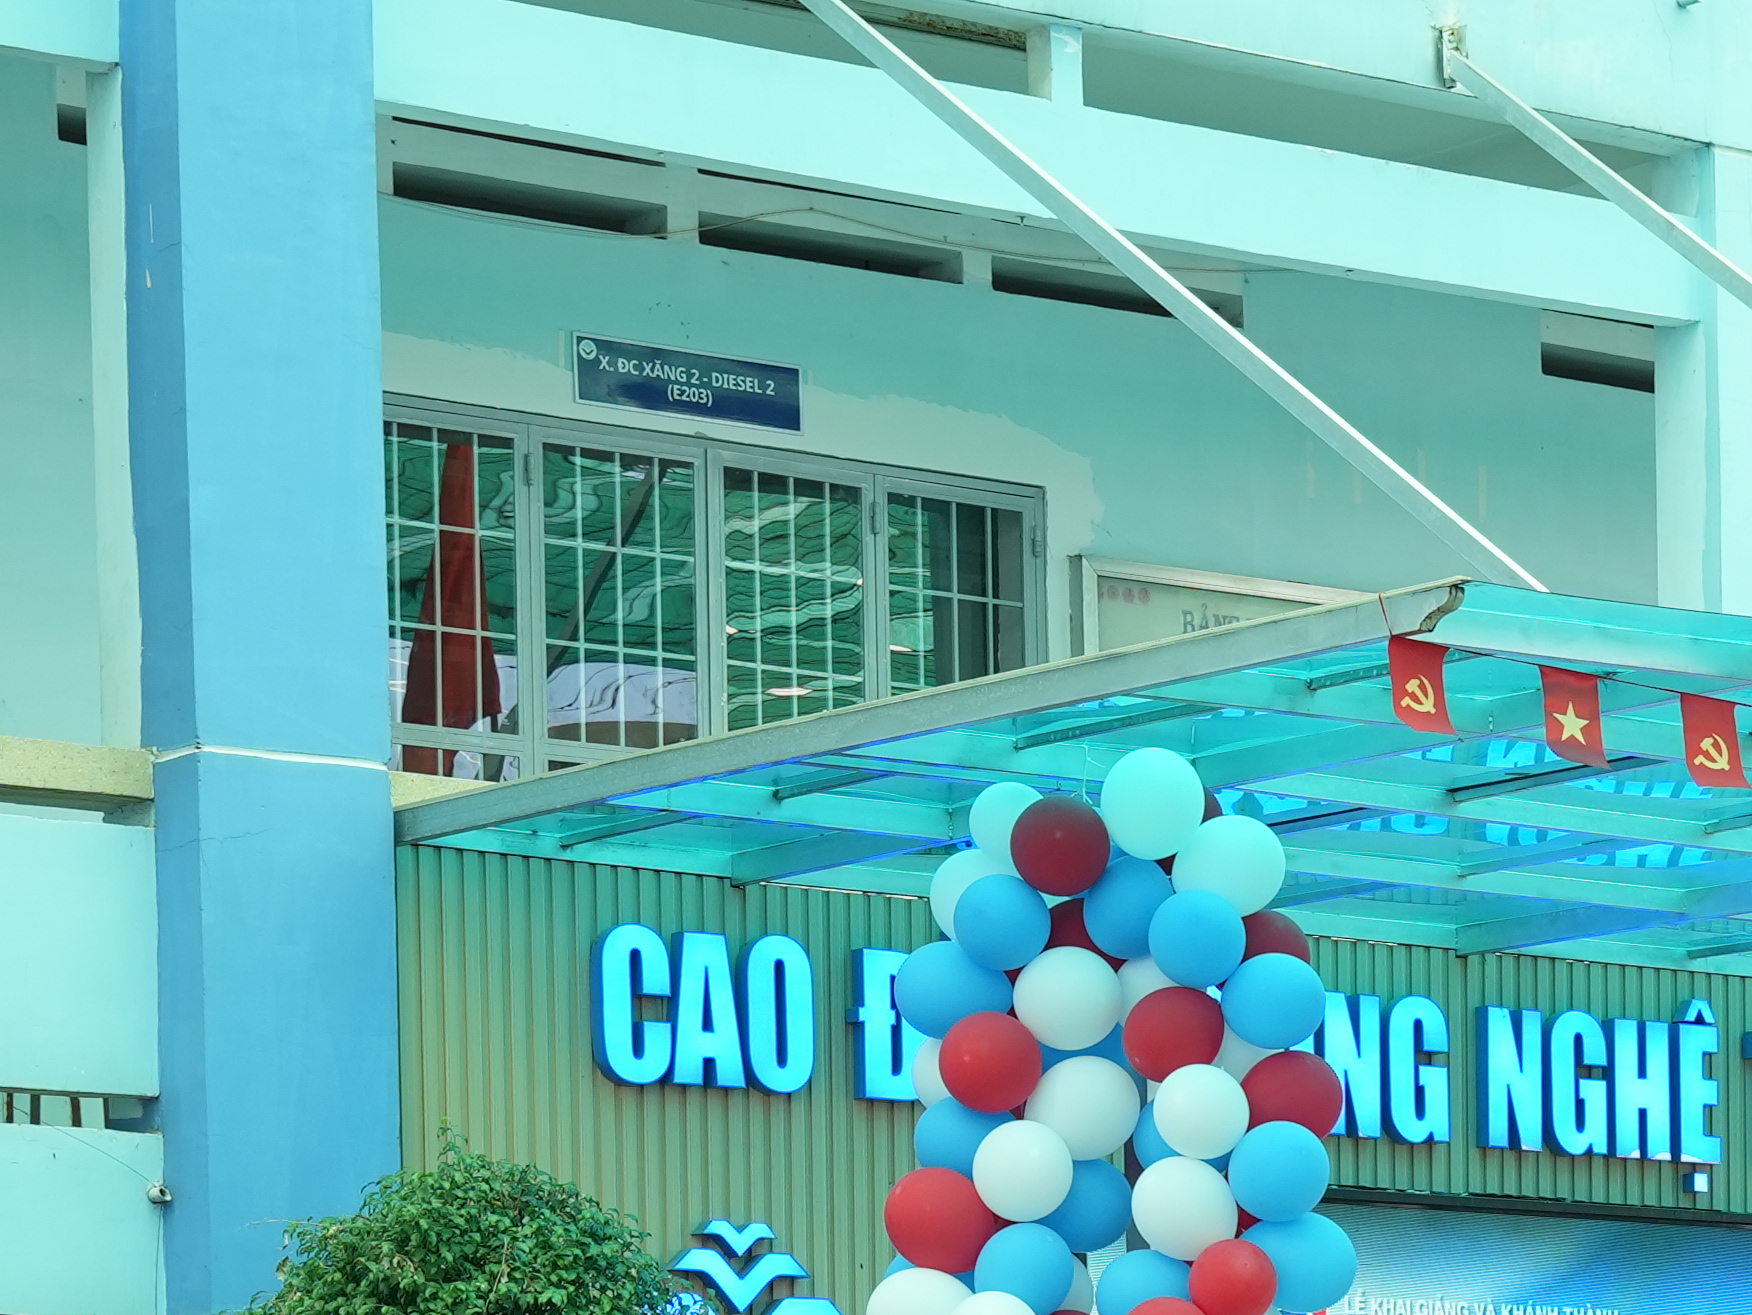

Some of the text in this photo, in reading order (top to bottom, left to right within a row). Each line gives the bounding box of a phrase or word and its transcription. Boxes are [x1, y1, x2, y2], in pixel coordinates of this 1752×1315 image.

[598, 354, 776, 395] X. ĐC XĂNG 2 DIESEL 2
[666, 384, 714, 408] (E203)
[591, 920, 814, 1096] CAO
[1474, 995, 1724, 1194] NGHỆ
